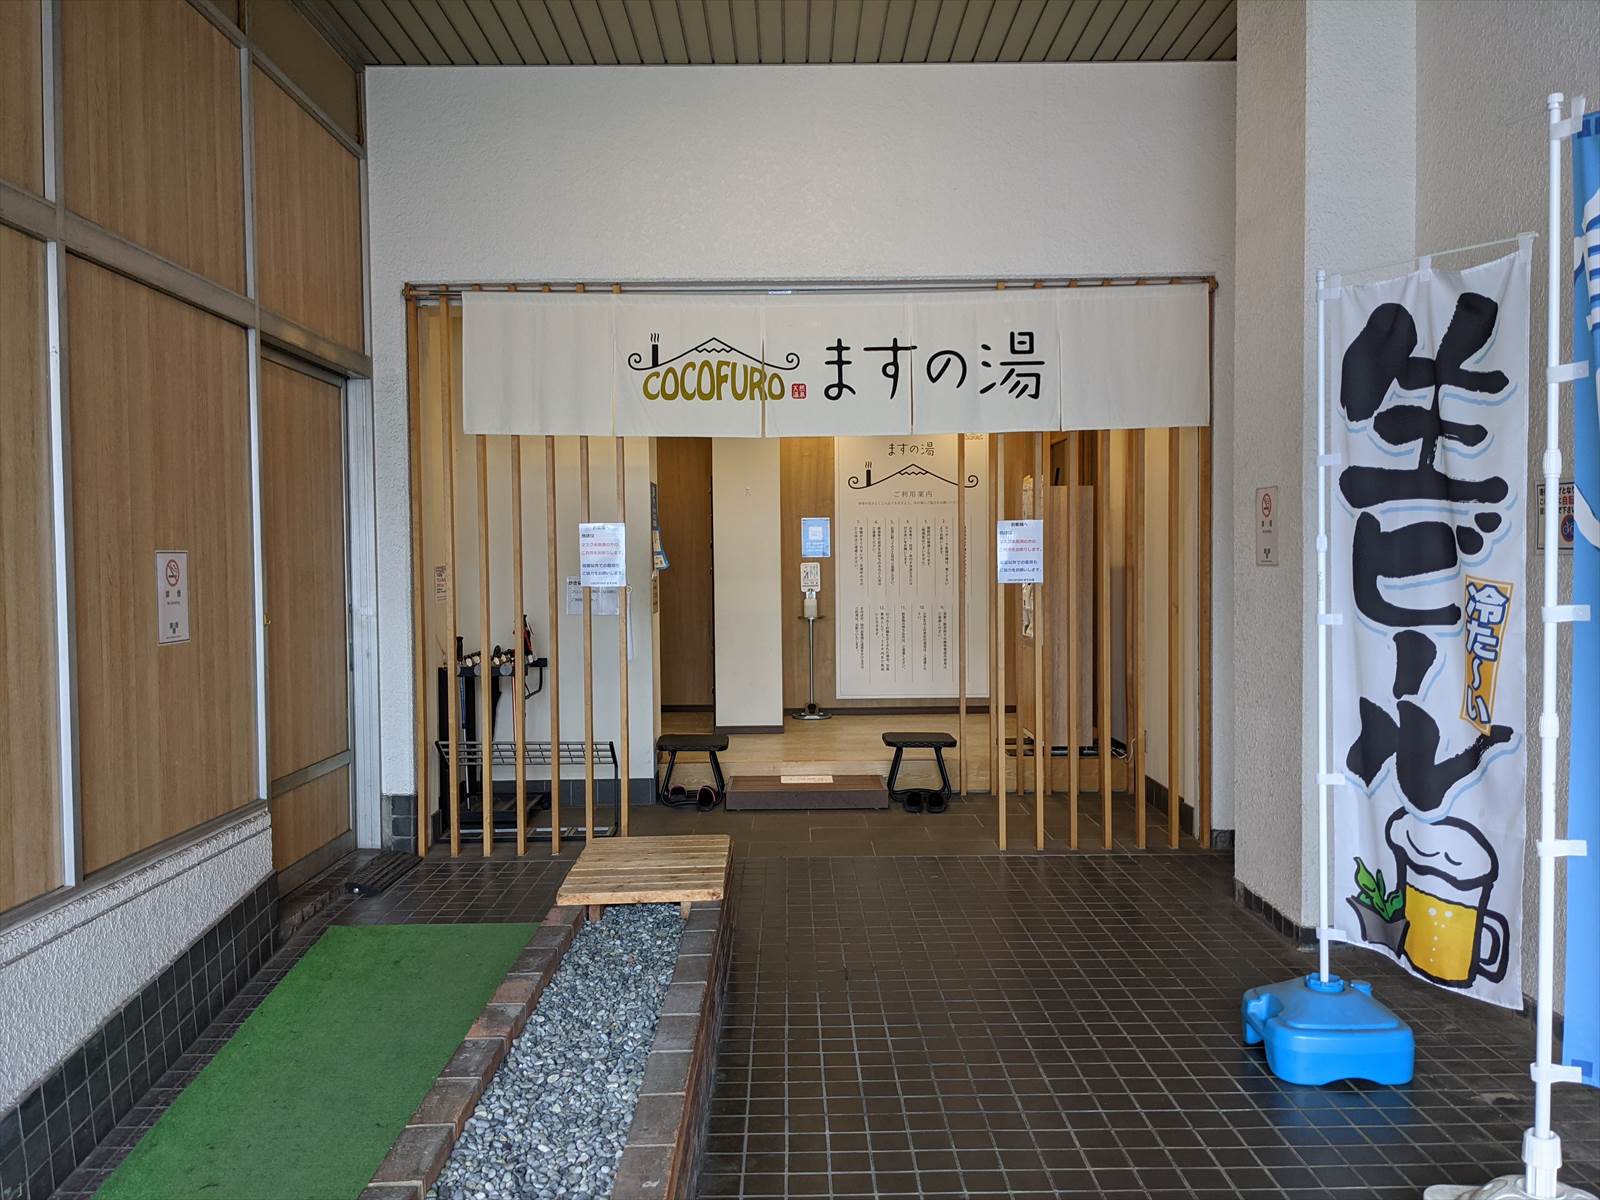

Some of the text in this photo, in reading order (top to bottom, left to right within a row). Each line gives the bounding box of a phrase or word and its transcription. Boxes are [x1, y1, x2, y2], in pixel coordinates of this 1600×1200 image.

[642, 331, 1046, 401] COCOFURO ますの湯
[888, 441, 936, 457] ますの湯
[893, 490, 933, 498] ご利用案内
[1339, 292, 1514, 812] 生ビール
